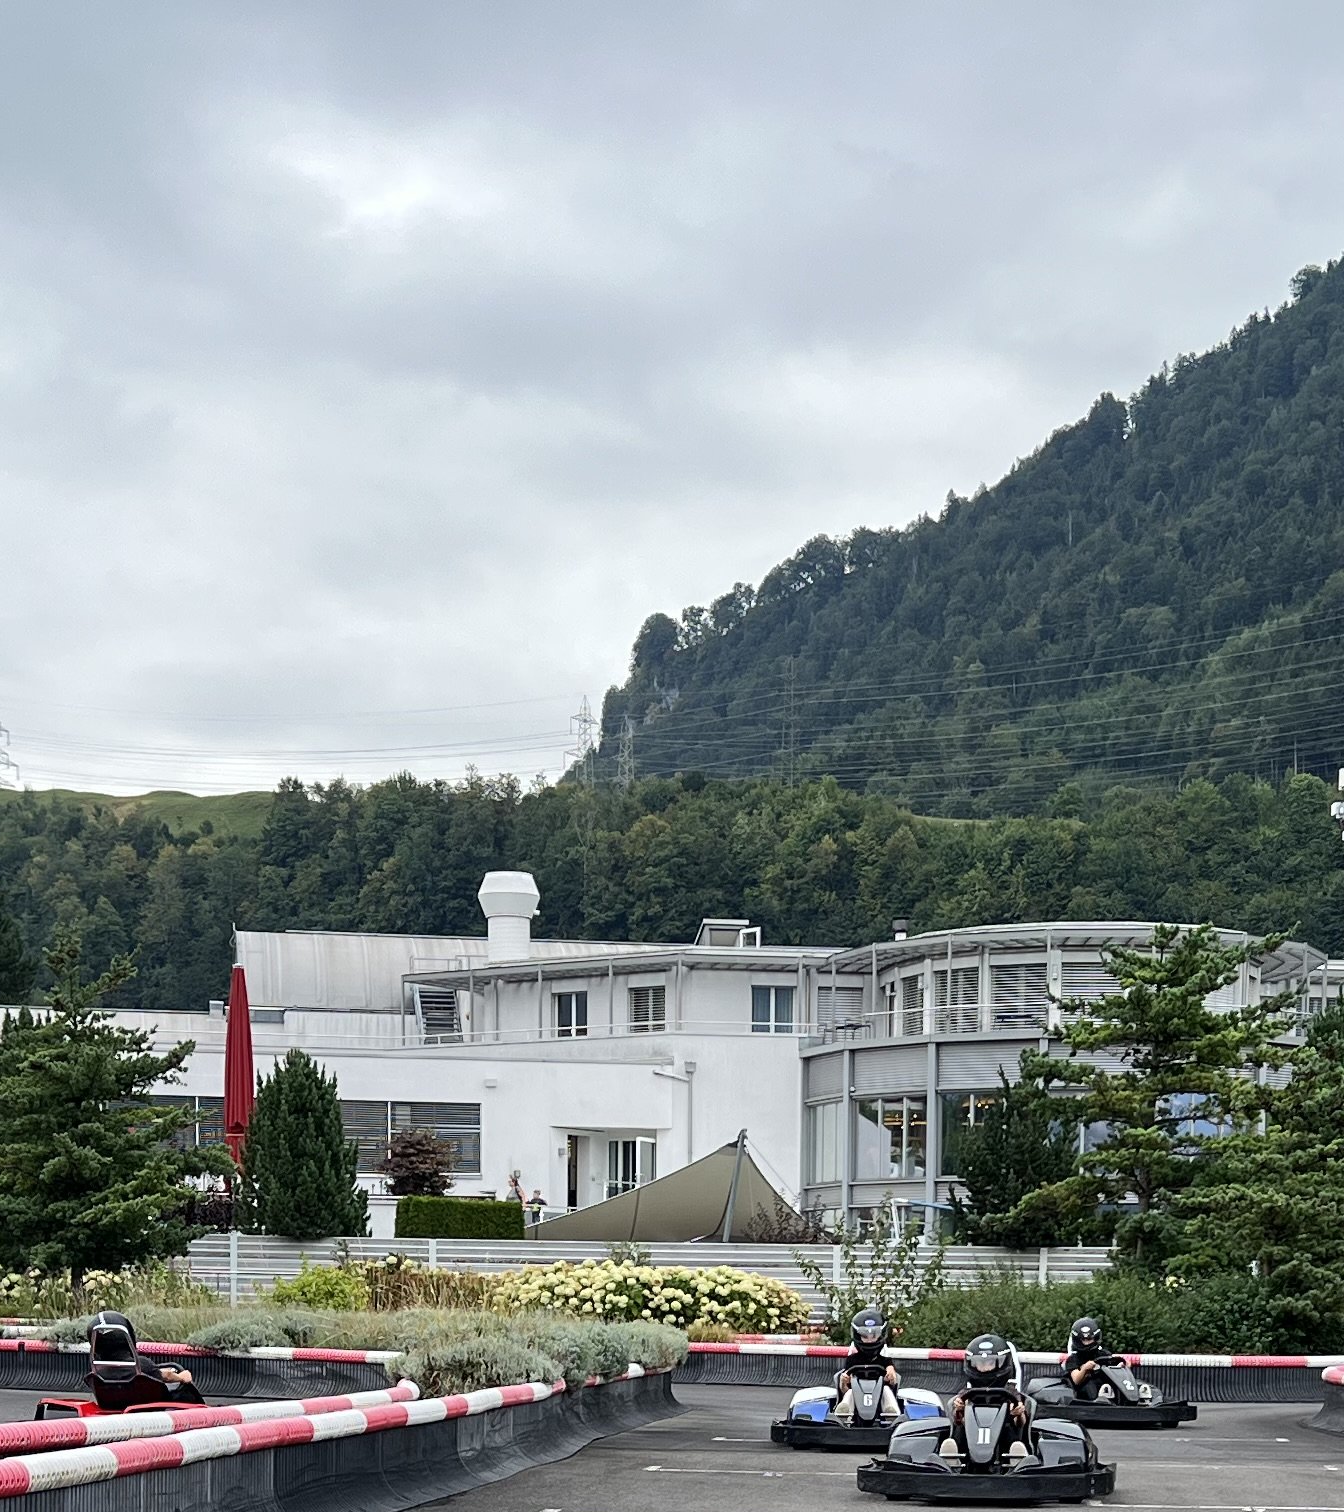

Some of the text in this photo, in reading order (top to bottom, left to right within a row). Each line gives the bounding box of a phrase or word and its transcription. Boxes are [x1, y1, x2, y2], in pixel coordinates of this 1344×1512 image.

[1122, 1379, 1135, 1391] 2
[863, 1394, 873, 1407] 6
[977, 1427, 991, 1445] 11
